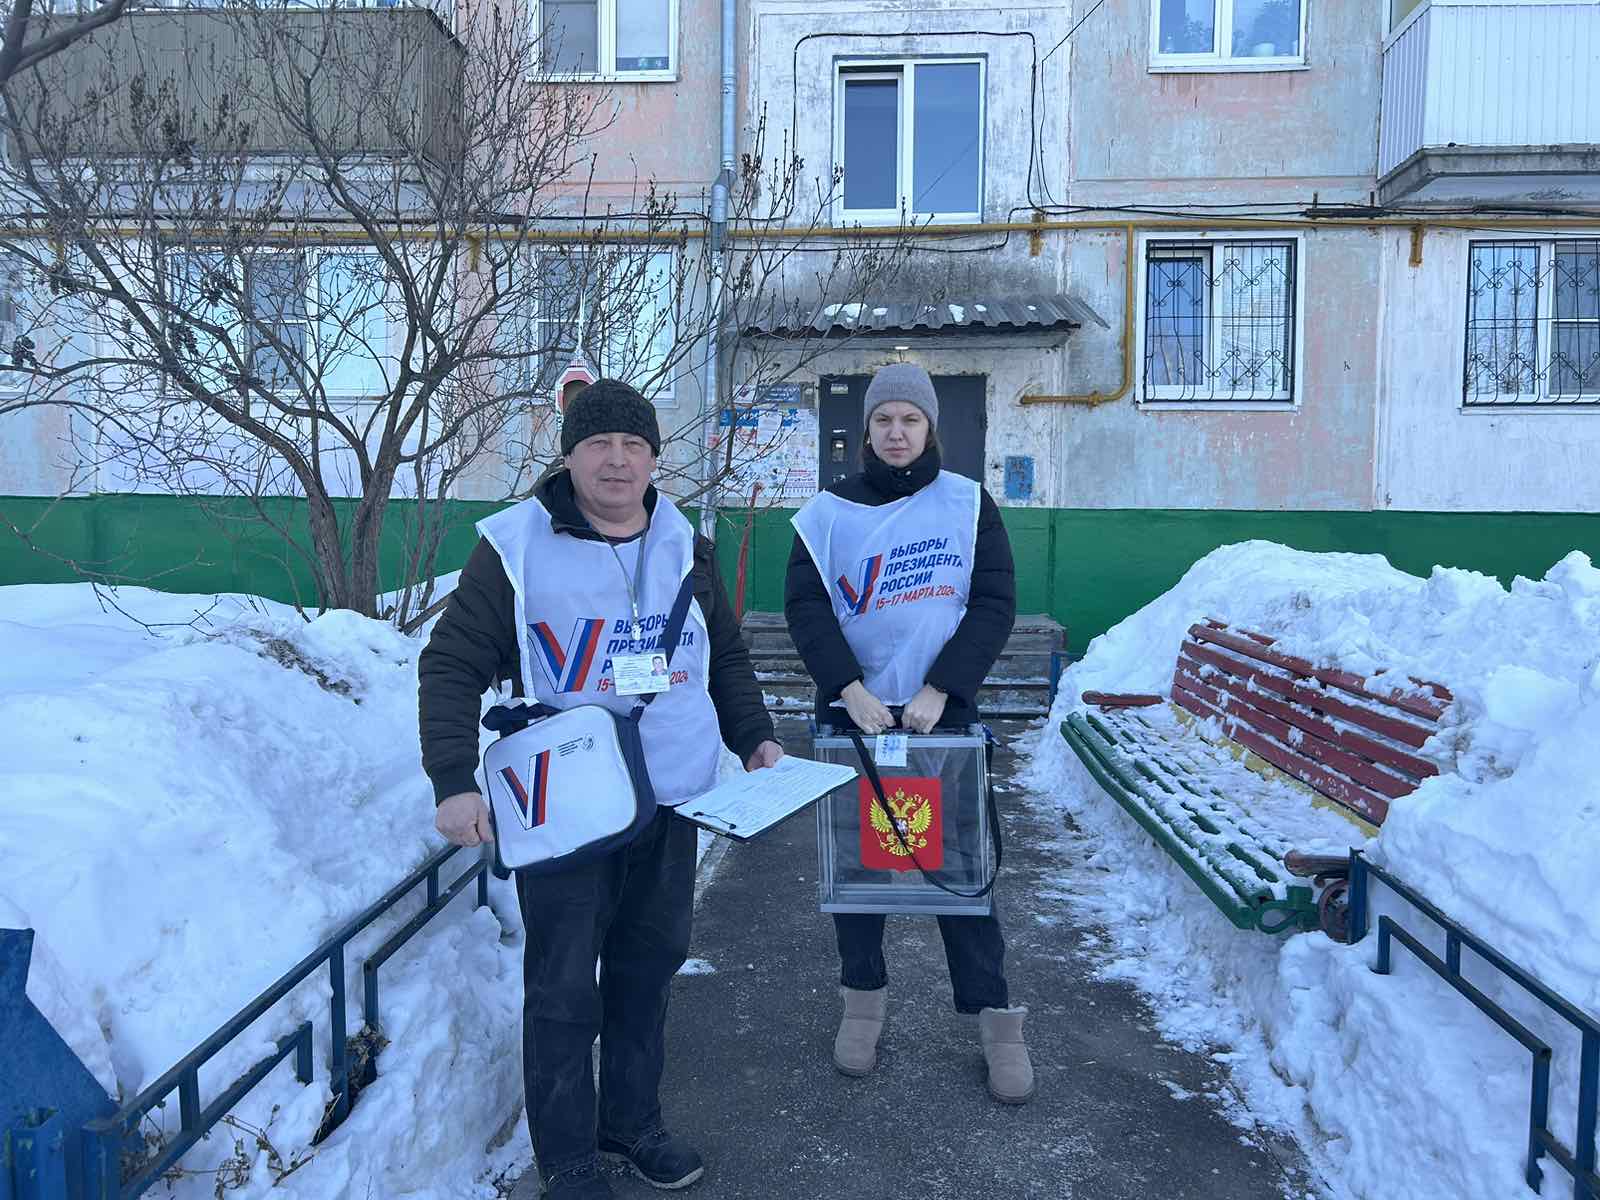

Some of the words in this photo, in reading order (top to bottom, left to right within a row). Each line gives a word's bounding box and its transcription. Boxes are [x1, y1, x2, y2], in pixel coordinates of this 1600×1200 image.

[890, 538, 948, 560] ВЫБОРЫ
[884, 553, 963, 577] ПРЕЗИДЕНТА
[879, 570, 933, 594] РОССИИ
[902, 586, 934, 604] МАРТА
[935, 585, 955, 597] 2024
